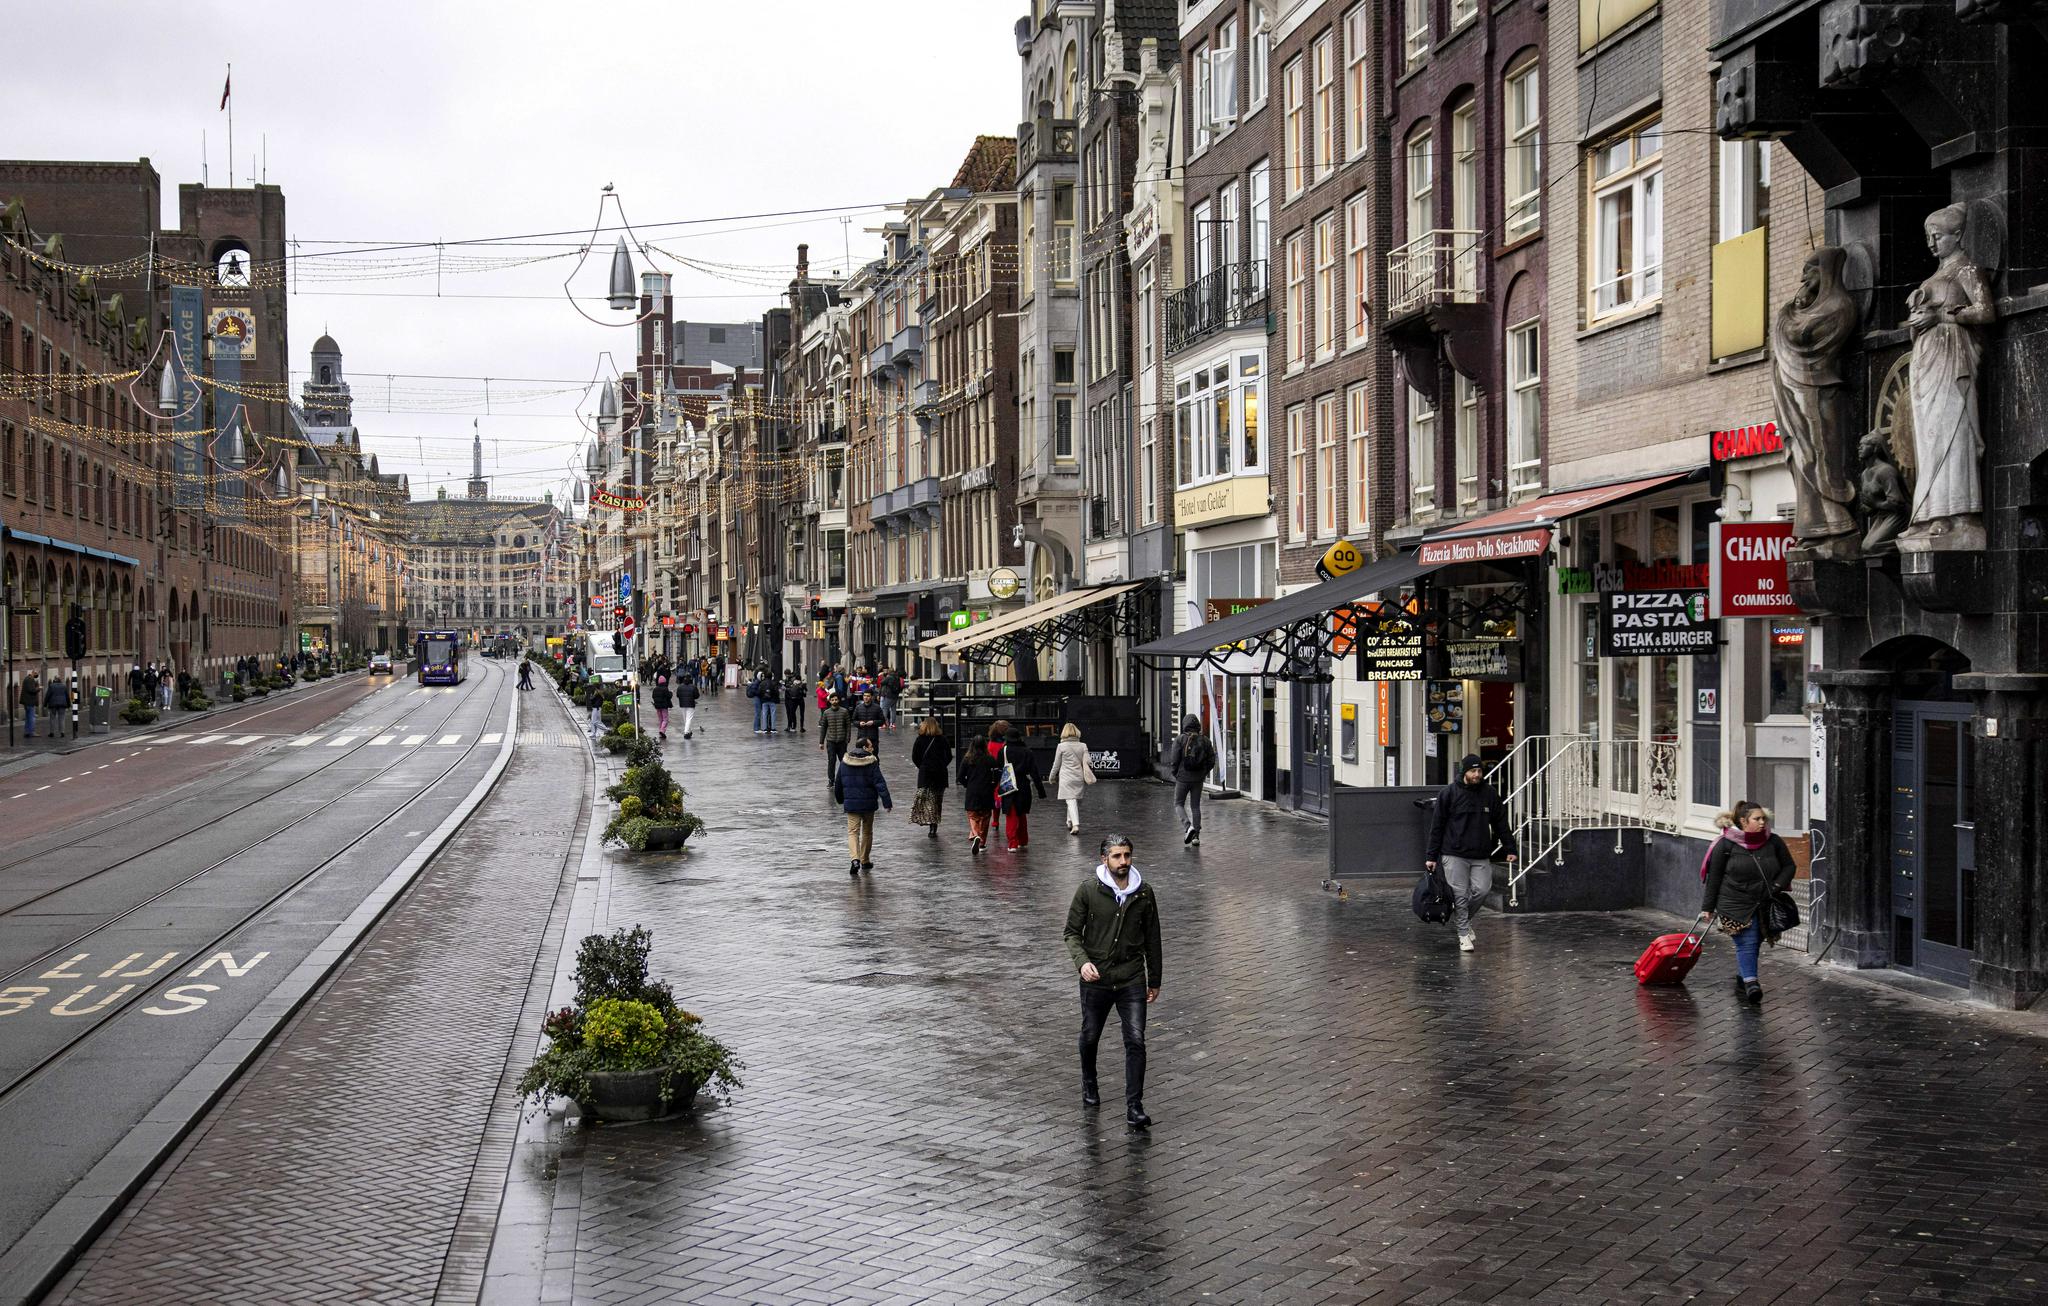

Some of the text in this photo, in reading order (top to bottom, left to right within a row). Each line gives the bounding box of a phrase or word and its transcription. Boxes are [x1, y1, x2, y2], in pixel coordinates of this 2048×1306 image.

[599, 493, 644, 509] CASINO
[1196, 499, 1207, 512] van
[1422, 545, 1450, 562] Pizzeria
[1451, 543, 1475, 561] Marco
[1476, 540, 1493, 558] Polo
[1558, 567, 1591, 595] Pizza
[1593, 562, 1624, 593] Pasta
[1758, 578, 1775, 590] NO
[1612, 593, 1685, 609] PIZZA
[1732, 594, 1796, 606] COMMISSIO
[1612, 612, 1690, 628] PASTA
[921, 630, 939, 638] HOTEL
[1613, 631, 1713, 647] STEAK & BURGER
[1779, 634, 1803, 643] OPEN
[1390, 638, 1397, 646] &
[1387, 647, 1411, 657] BREAKFAST
[1632, 646, 1693, 654] BREAKFAST
[1376, 660, 1414, 668] PANCAKES
[1368, 670, 1422, 680] BREAKFAST
